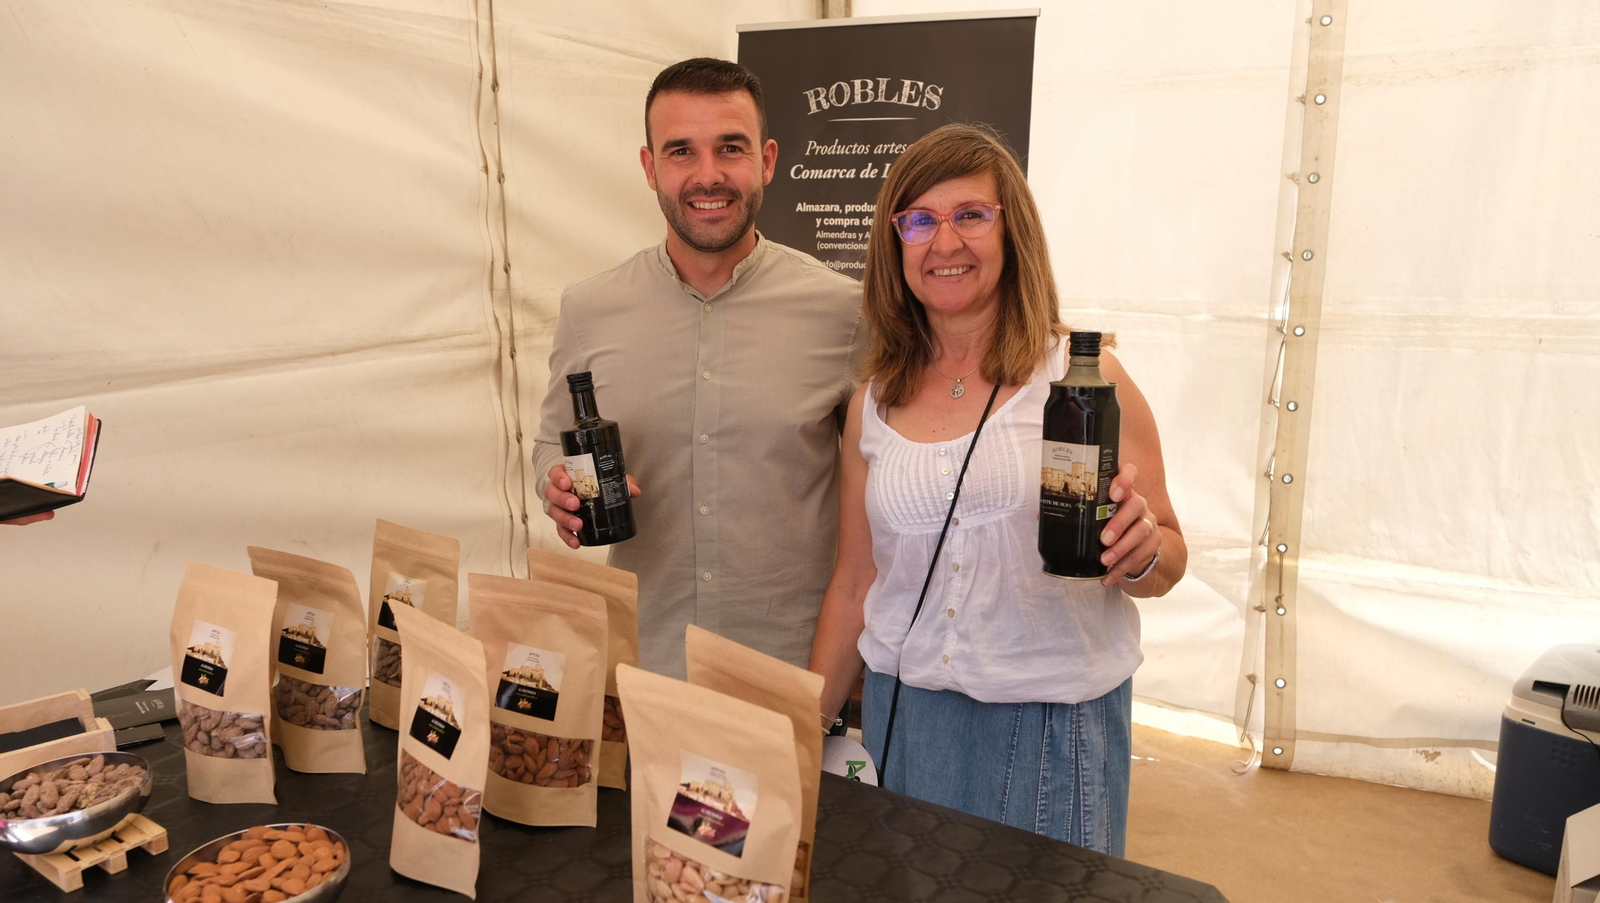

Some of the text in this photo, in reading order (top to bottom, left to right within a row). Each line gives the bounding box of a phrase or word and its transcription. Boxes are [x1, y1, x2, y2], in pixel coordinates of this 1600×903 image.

[803, 77, 944, 115] ROBLES
[804, 138, 871, 156] Productos
[789, 164, 857, 180] Comarca
[859, 162, 879, 179] de
[795, 202, 843, 214] Almazara,
[815, 215, 874, 228] y compra de
[815, 230, 857, 239] Almendras
[858, 232, 863, 240] y
